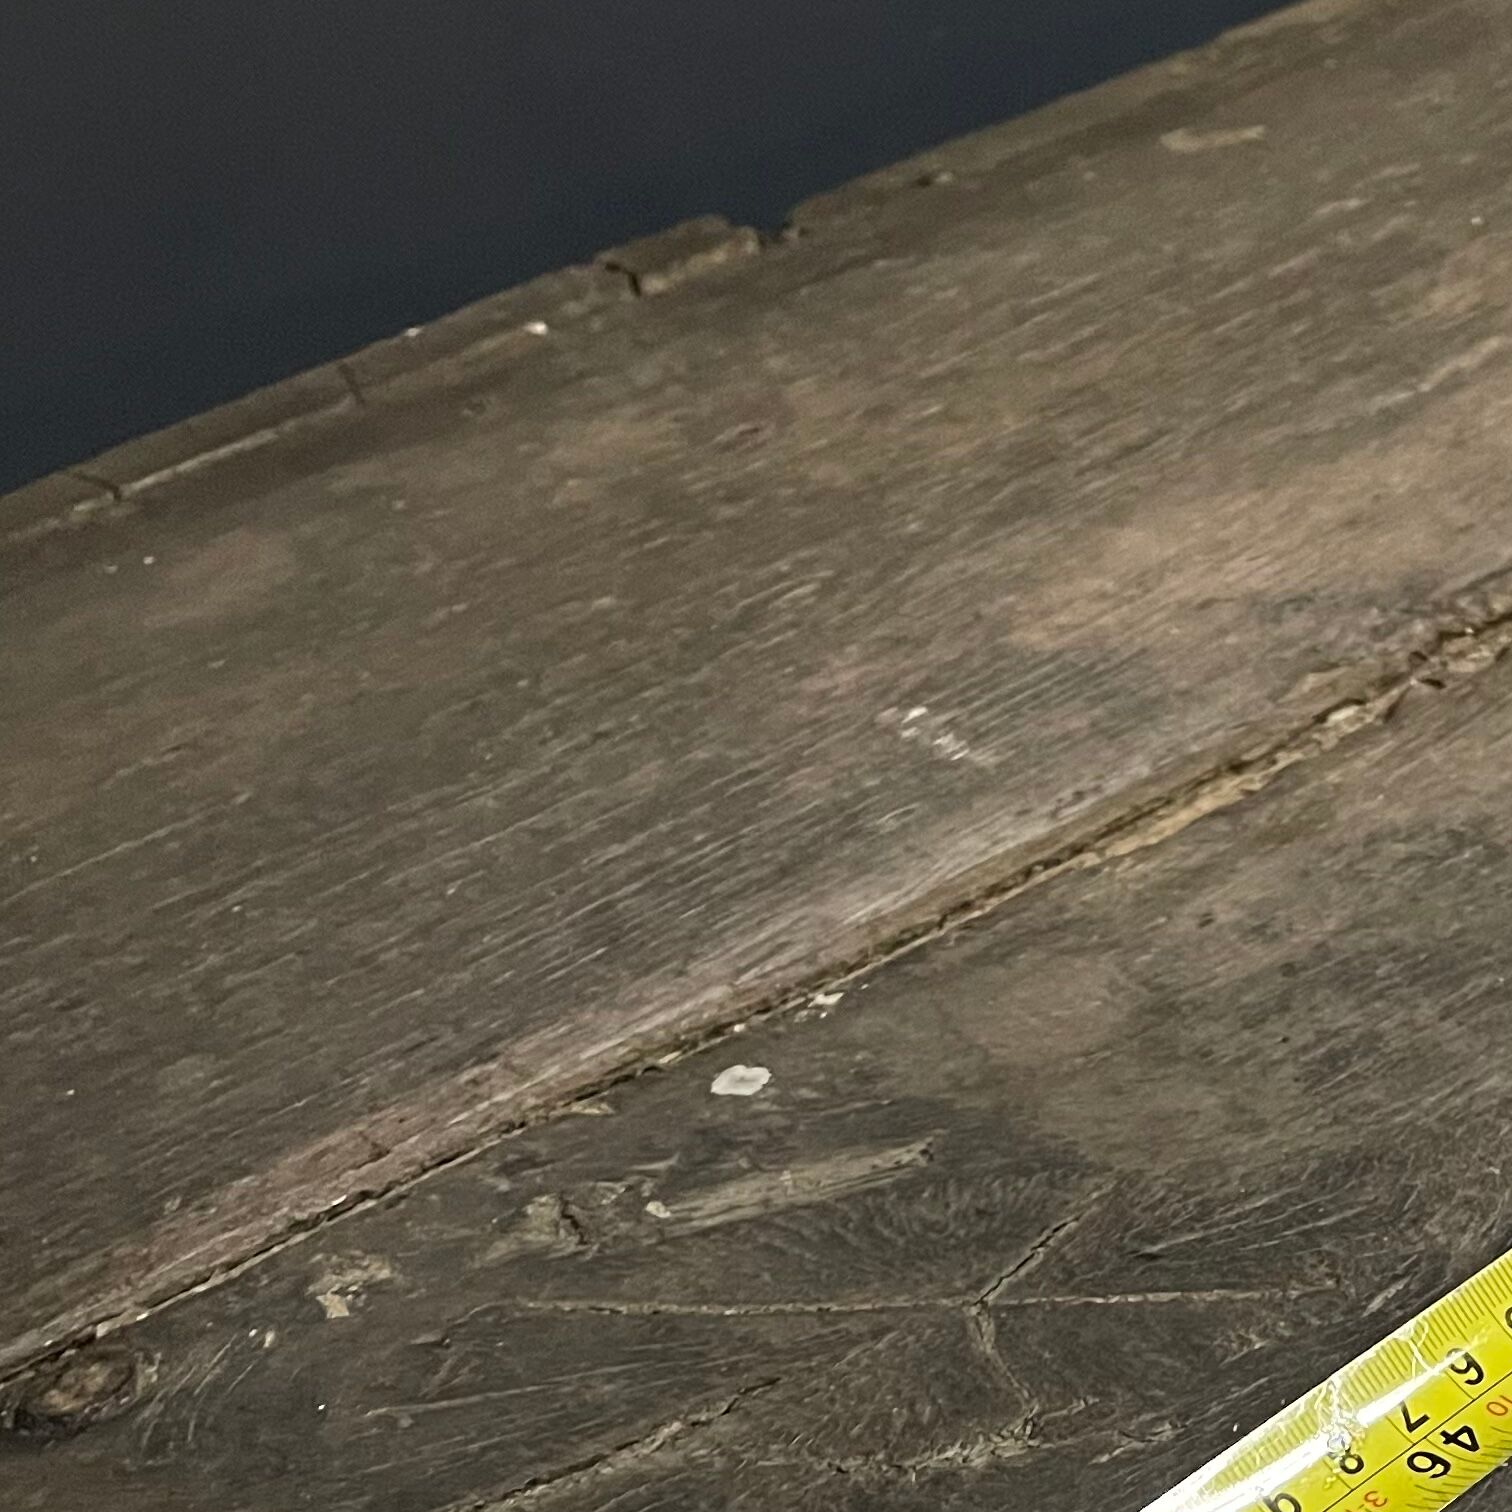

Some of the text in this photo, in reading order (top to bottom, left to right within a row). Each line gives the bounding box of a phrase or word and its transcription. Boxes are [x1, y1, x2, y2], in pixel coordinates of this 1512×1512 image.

[1447, 1347, 1485, 1387] 6
[1399, 1400, 1430, 1434] 7
[1405, 1424, 1481, 1480] 46
